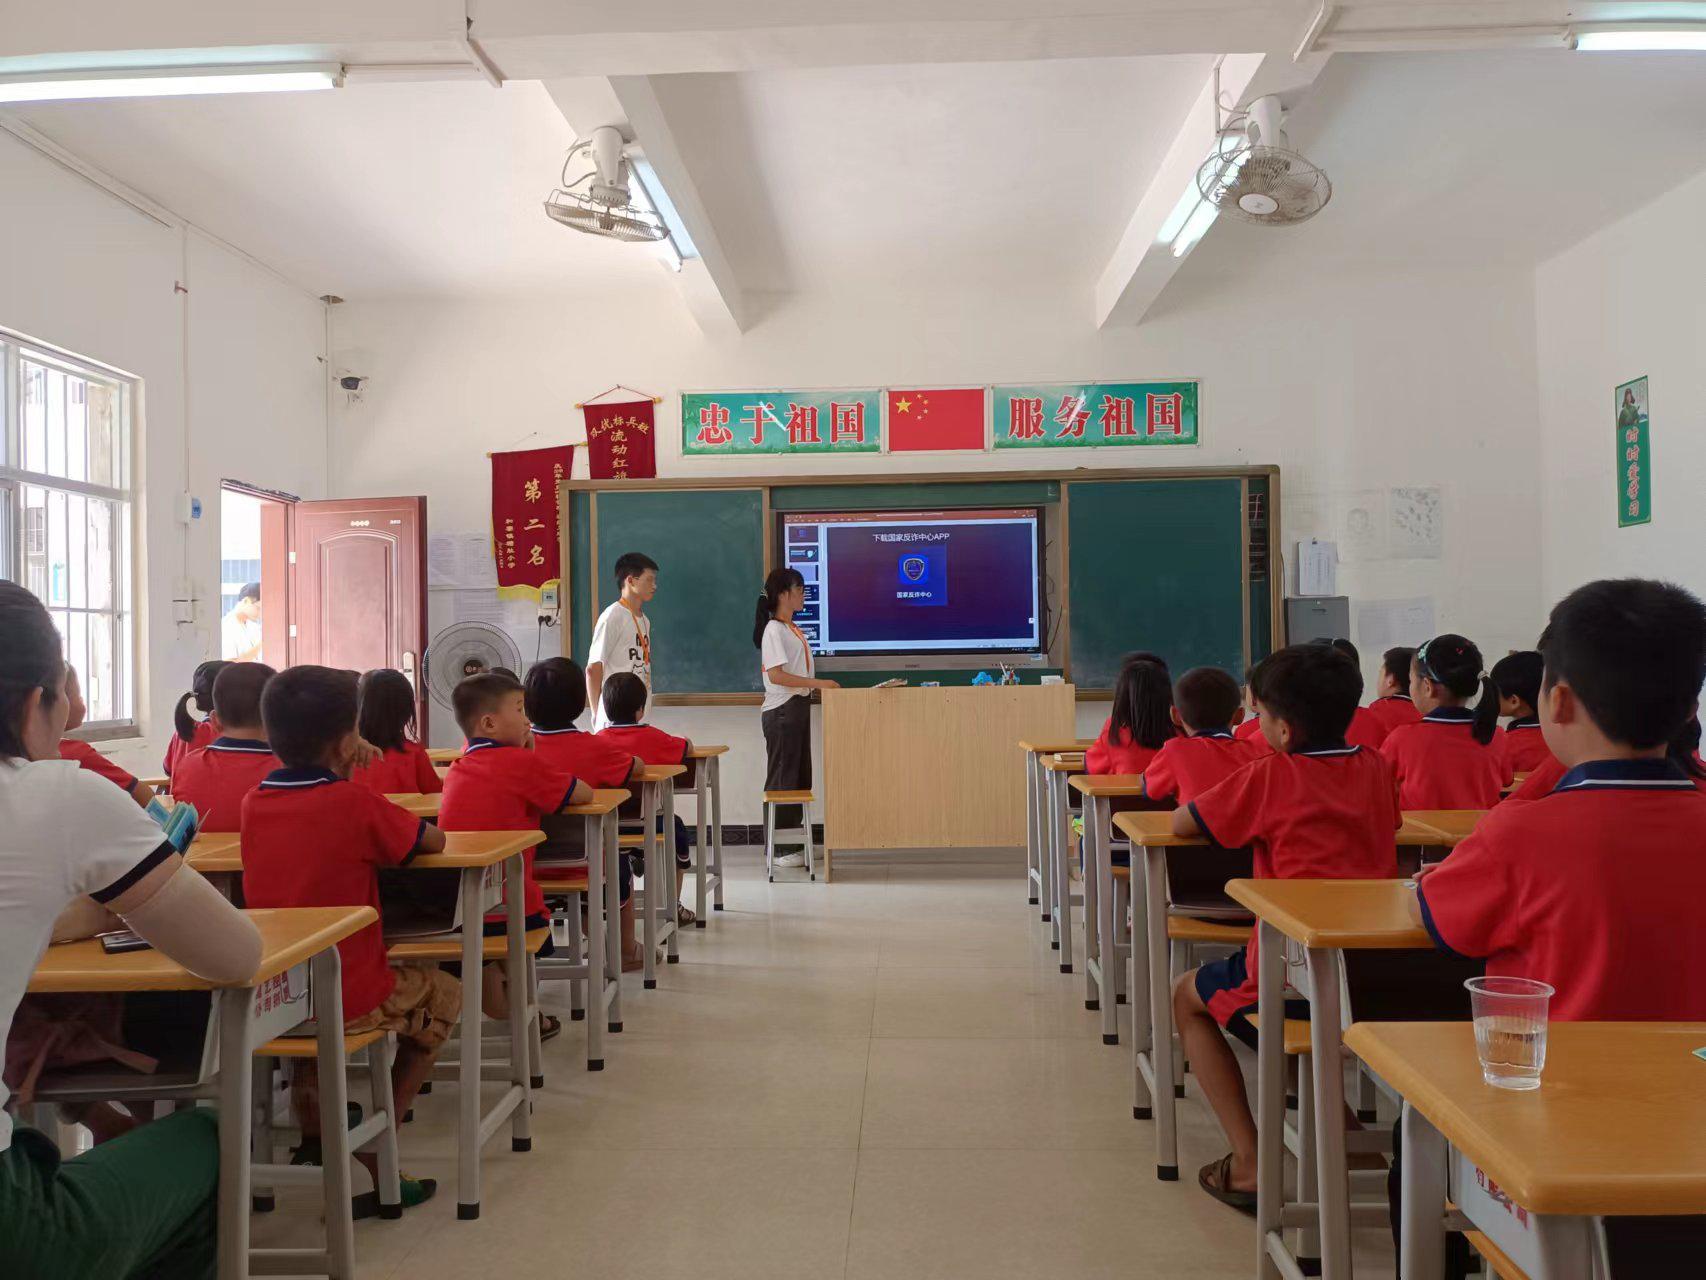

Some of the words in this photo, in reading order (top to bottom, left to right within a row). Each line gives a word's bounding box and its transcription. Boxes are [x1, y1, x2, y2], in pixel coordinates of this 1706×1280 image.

[697, 401, 865, 445] 忠于祖国
[1007, 392, 1184, 439] 服务祖国
[523, 477, 546, 567] 第二名
